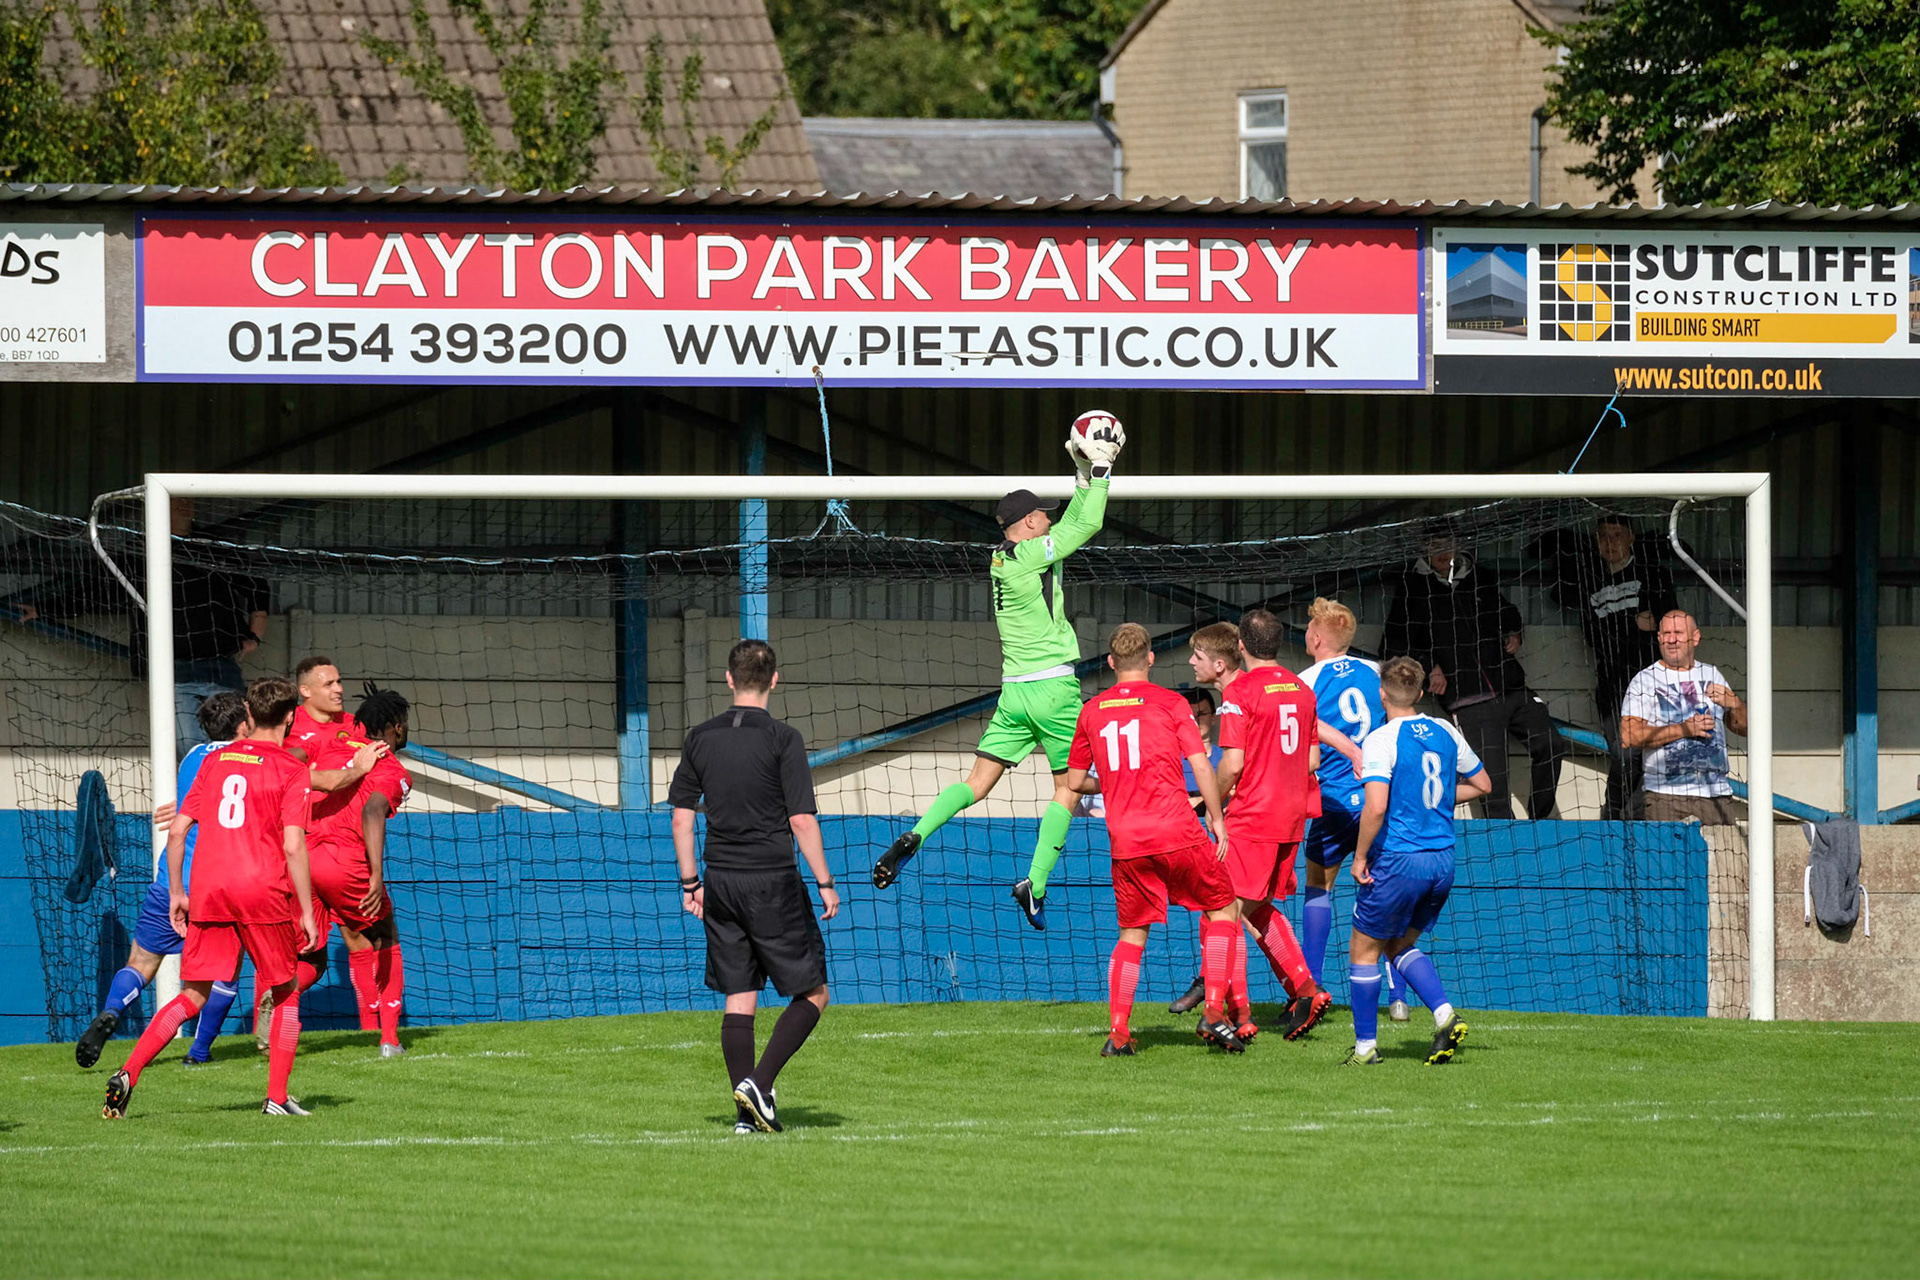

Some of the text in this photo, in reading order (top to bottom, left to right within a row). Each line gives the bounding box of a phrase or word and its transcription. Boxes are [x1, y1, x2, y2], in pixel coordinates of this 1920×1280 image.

[250, 231, 1312, 304] CLAYTON PARK BAKERY
[1635, 244, 1896, 282] SUTCLIFFE
[1635, 290, 1897, 307] CONSTRUCTION LTD
[26, 327, 86, 343] 427601
[228, 320, 1339, 369] 01254 393200 WWW.PIETASTIC.CO.UK
[1641, 317, 1761, 338] BUILDING SMART
[12, 350, 33, 361] BB7
[38, 350, 60, 361] 1QD
[1614, 362, 1823, 391] www.sutcon.co.uk
[1278, 704, 1299, 756] 5
[1338, 687, 1371, 744] 9
[1099, 719, 1141, 772] 11
[218, 773, 248, 829] 8
[1421, 751, 1444, 810] 8
